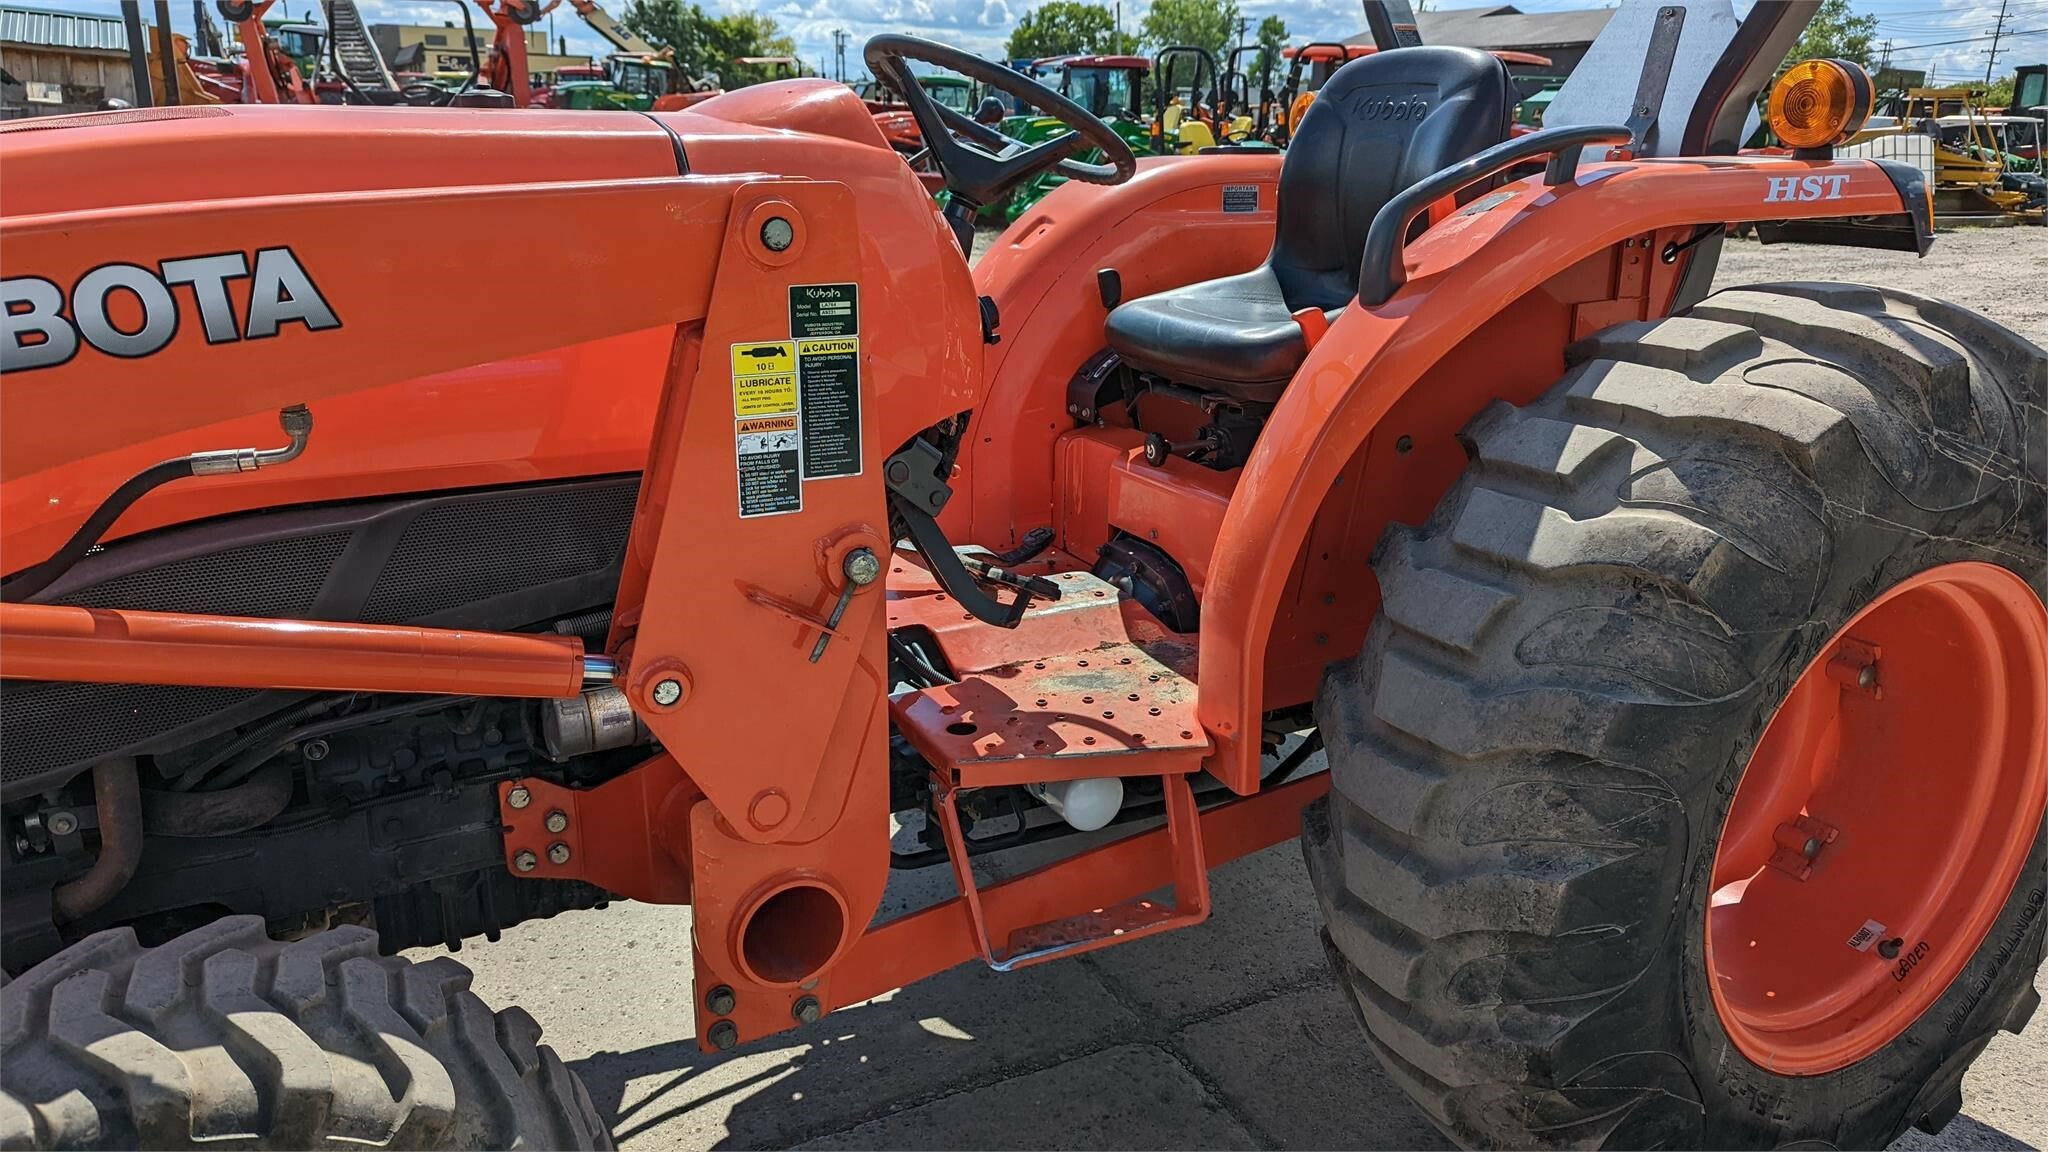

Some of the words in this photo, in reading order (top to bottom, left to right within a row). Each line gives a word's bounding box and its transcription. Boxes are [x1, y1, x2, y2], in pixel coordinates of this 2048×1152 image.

[1352, 94, 1428, 121] Kubota
[1763, 175, 1850, 203] HST
[806, 288, 841, 298] Kubota
[812, 342, 854, 352] CAUTION
[756, 362, 767, 371] 10
[740, 377, 792, 388] LUBRICATE
[750, 419, 794, 430] WARNING
